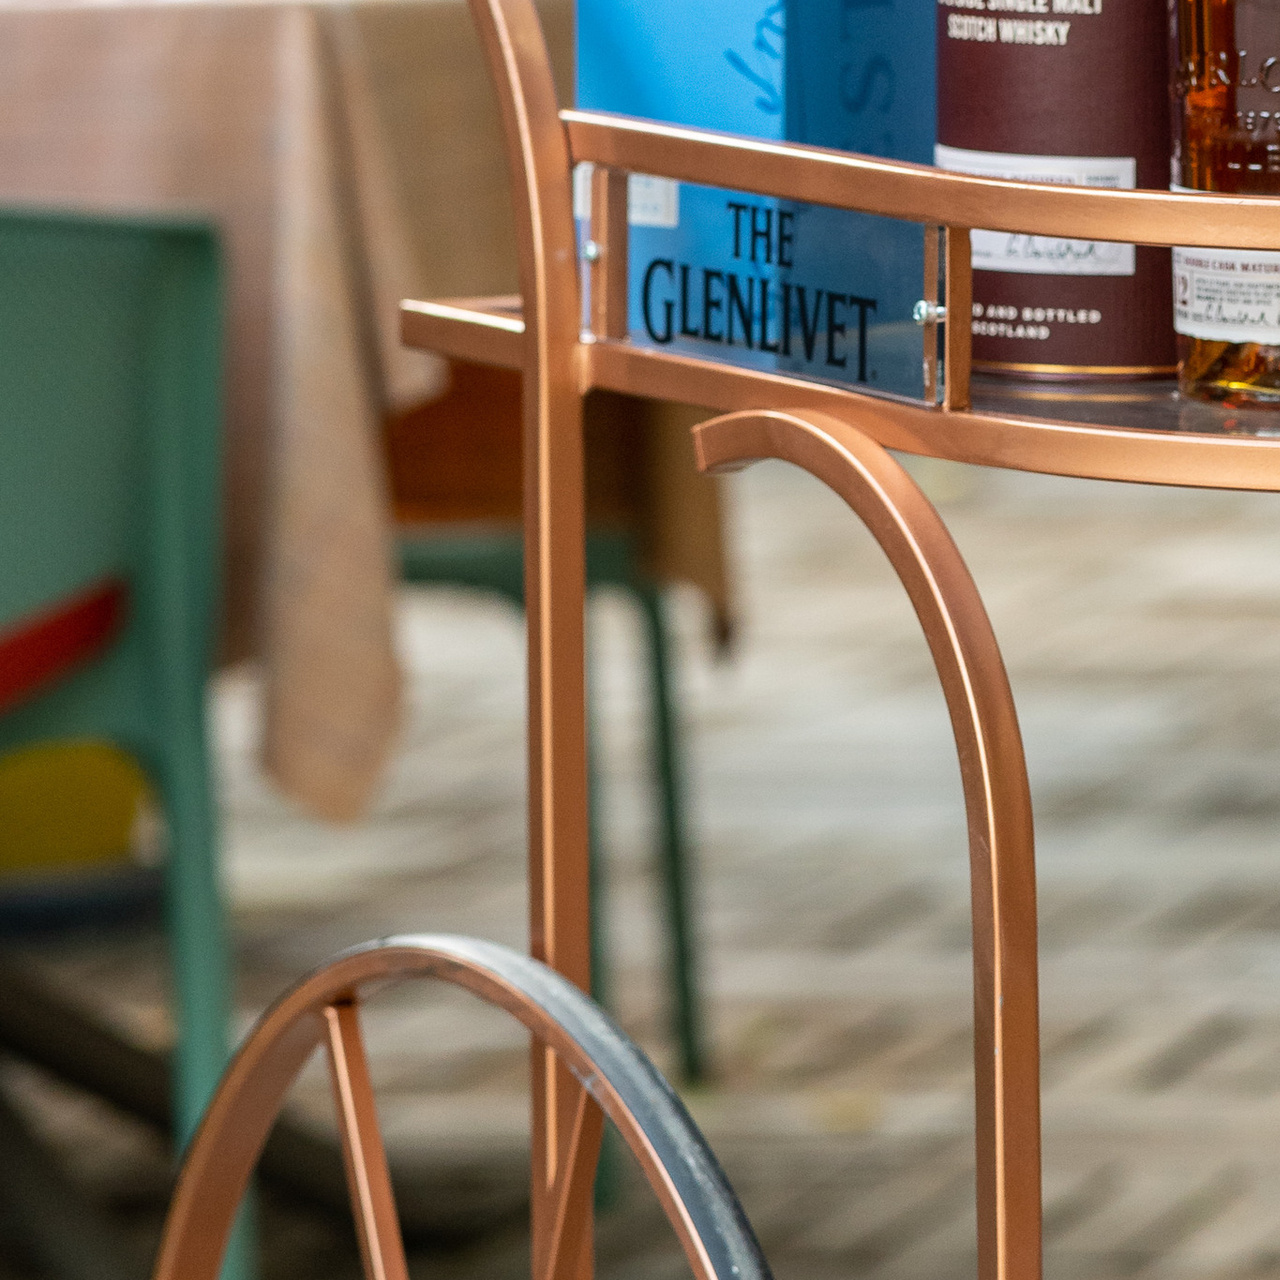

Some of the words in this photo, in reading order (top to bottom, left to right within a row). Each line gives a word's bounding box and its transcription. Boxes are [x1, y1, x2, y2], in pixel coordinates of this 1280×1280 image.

[999, 18, 1071, 45] WHISKY
[727, 200, 794, 268] THE
[641, 258, 878, 383] GLENLIVET
[1022, 307, 1102, 324] BOTTLED
